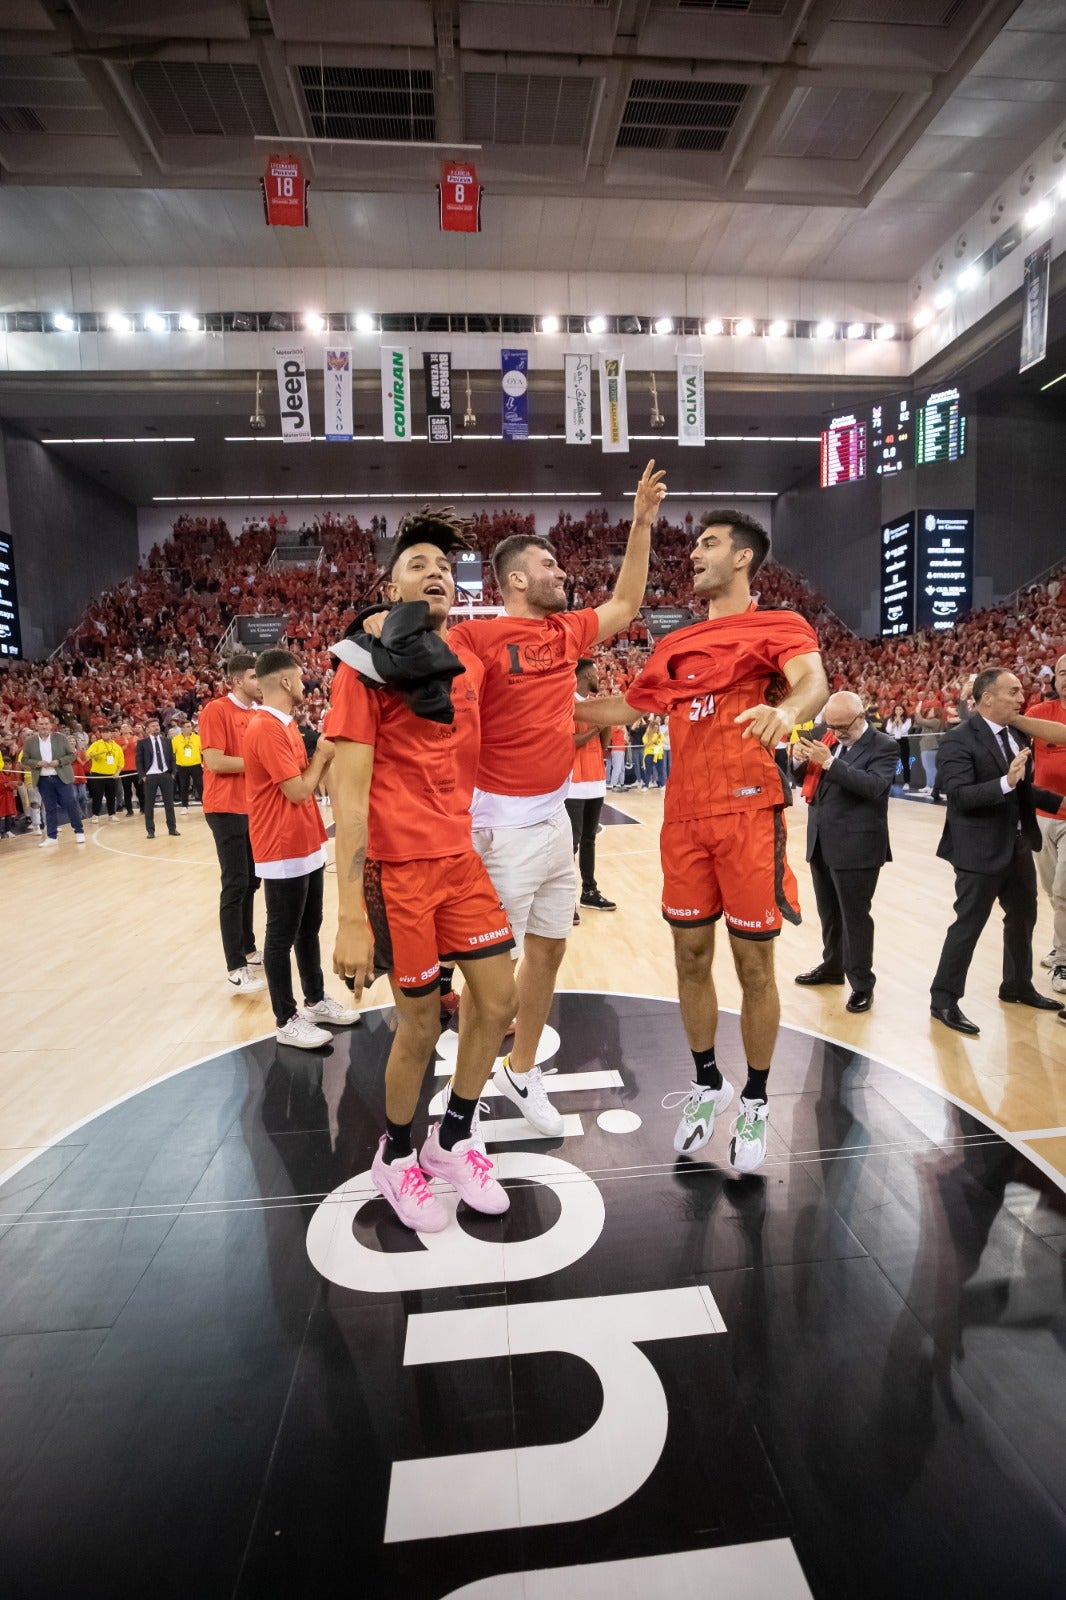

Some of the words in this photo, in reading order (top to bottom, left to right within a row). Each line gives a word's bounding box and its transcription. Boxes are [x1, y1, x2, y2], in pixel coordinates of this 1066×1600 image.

[277, 177, 294, 197] 18
[455, 184, 465, 203] 8
[281, 360, 305, 429] Jeep
[431, 364, 440, 398] VERDAD
[439, 353, 451, 410] BURGERS
[334, 374, 344, 431] MANZANO
[686, 376, 697, 425] OLIVA
[479, 927, 509, 944] BERNER
[730, 917, 762, 929] BERNER
[420, 962, 440, 981] asis
